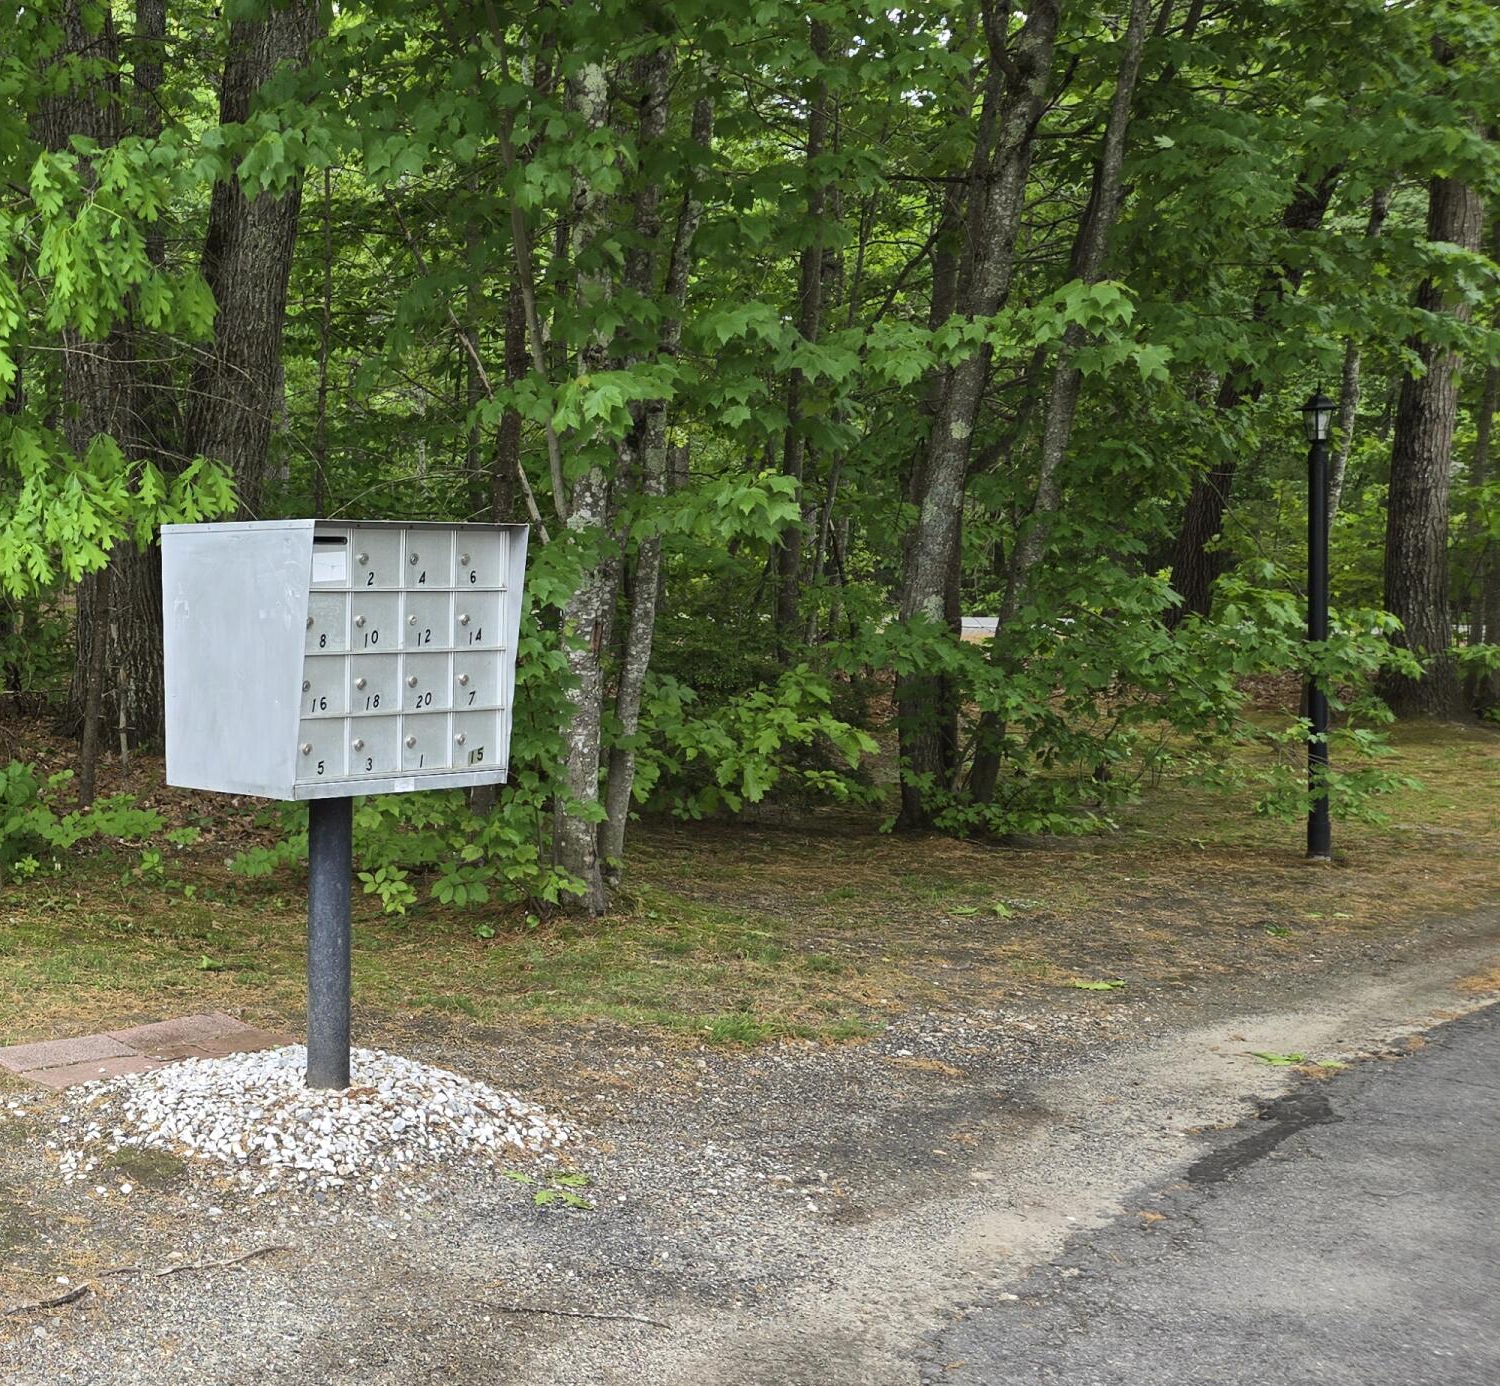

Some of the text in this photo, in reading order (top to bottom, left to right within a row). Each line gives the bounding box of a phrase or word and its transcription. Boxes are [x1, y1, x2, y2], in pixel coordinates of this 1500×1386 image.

[367, 571, 375, 586] 2
[418, 570, 426, 585] 4
[470, 570, 477, 584] 6
[319, 633, 327, 648] 8
[364, 629, 379, 648] 10
[417, 628, 431, 647] 12
[469, 627, 482, 645] 14
[311, 696, 327, 713] 16
[365, 694, 380, 711] 18
[415, 692, 432, 709] 20
[468, 690, 476, 706] 7
[419, 754, 424, 769] 1
[470, 747, 484, 764] 15
[317, 760, 325, 775] 5
[365, 757, 373, 772] 3
